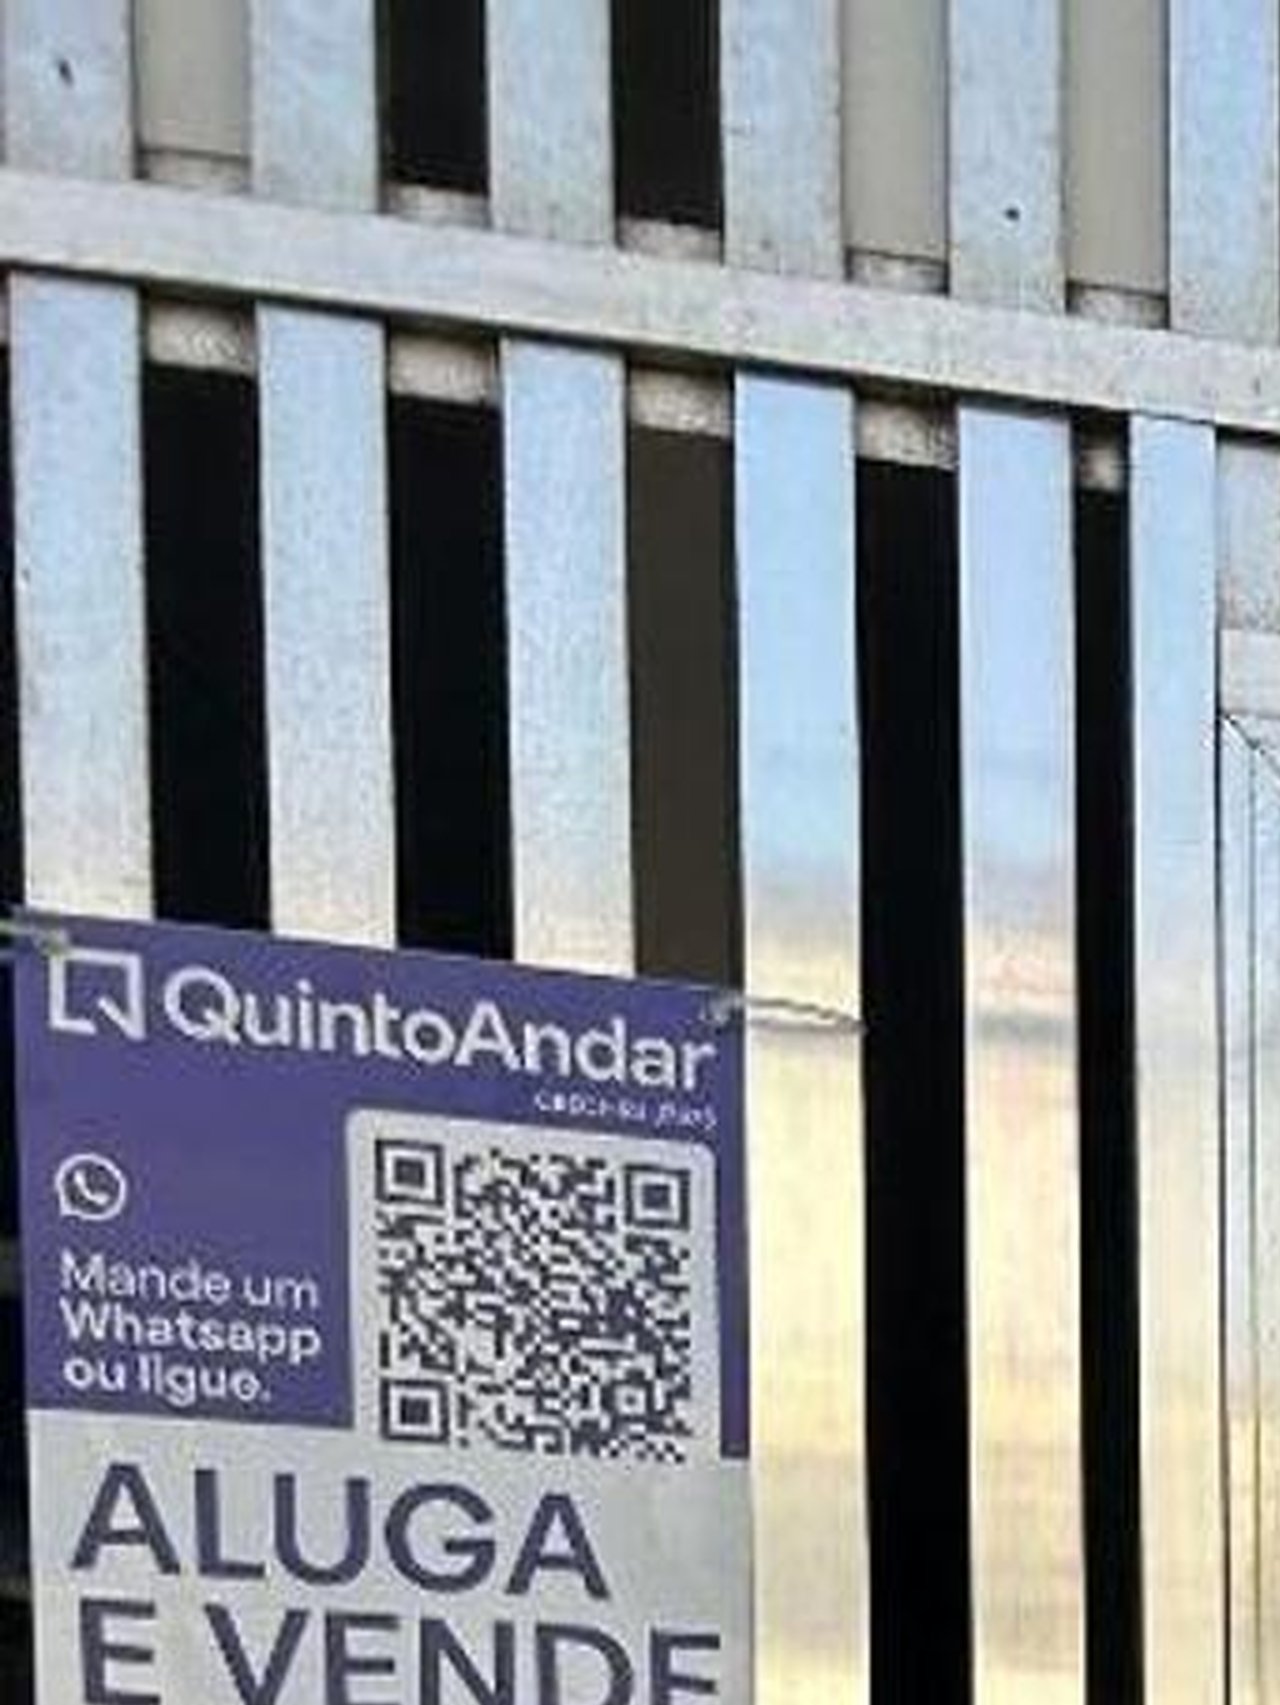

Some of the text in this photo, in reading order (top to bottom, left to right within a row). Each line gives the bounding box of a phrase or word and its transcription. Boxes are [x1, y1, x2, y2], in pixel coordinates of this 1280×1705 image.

[162, 966, 716, 1090] QuintoAndar
[60, 1250, 319, 1310] Mande um
[60, 1296, 321, 1364] Whatsapp
[63, 1352, 271, 1406] ou ligue.
[69, 1460, 611, 1601] ALUGA
